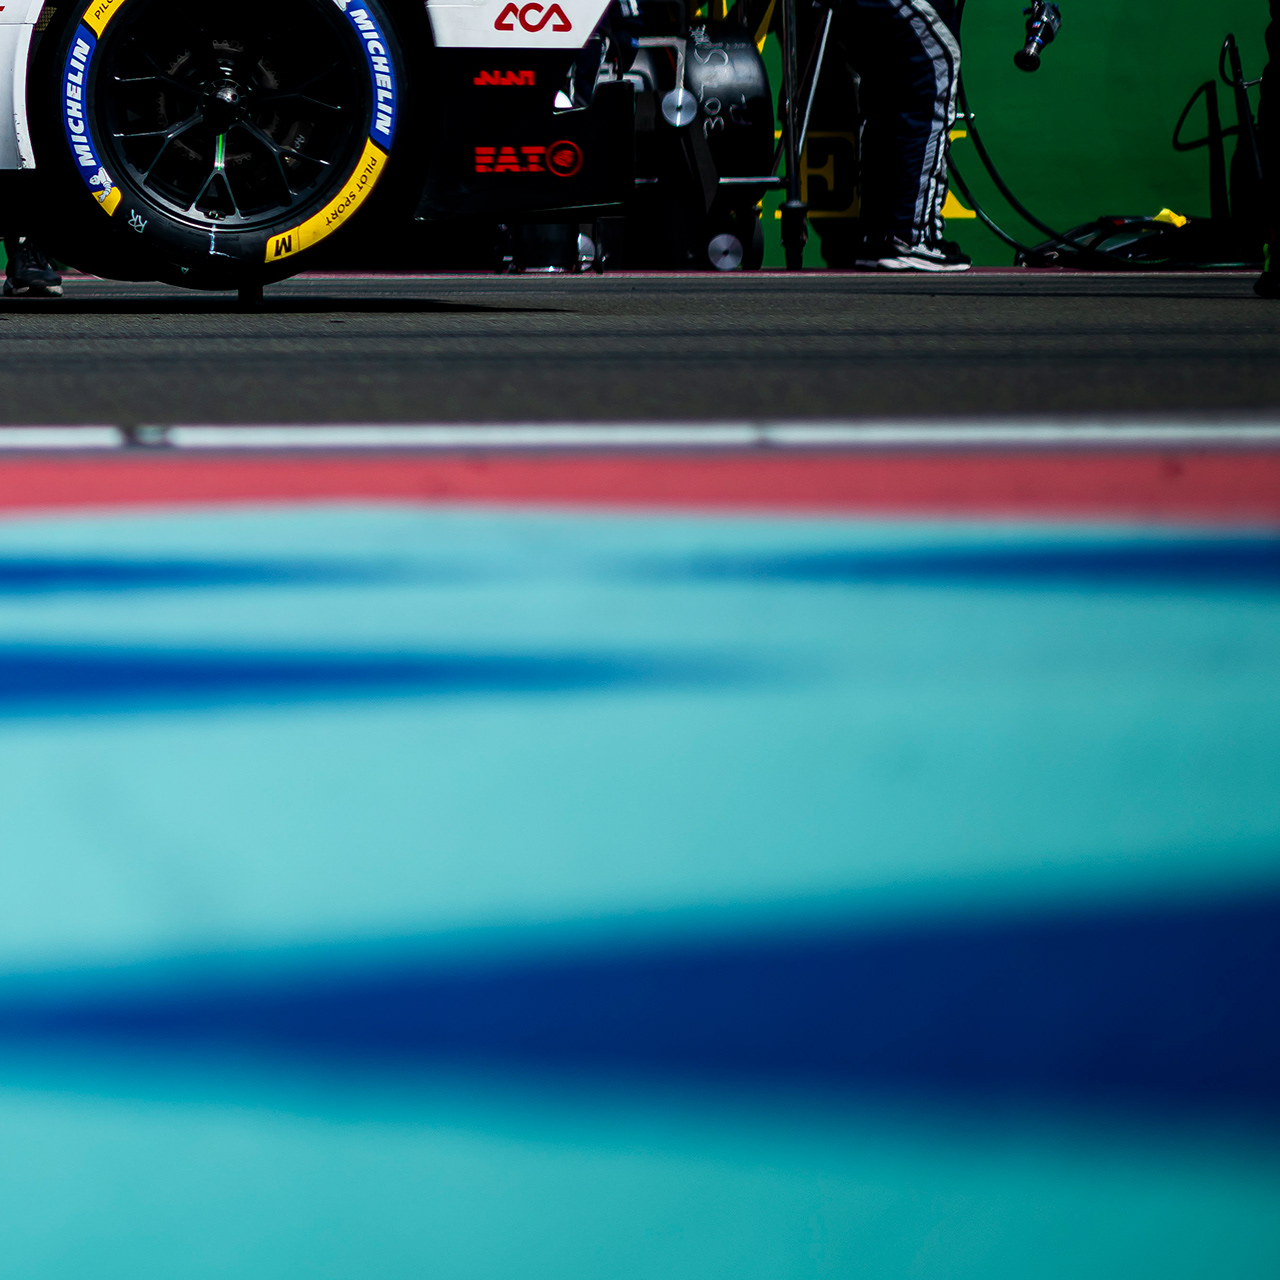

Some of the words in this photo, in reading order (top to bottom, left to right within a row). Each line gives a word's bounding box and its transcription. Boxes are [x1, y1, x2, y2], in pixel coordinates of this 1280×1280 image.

[67, 38, 97, 166] MICHELIN
[349, 9, 394, 134] MICHELIN
[325, 192, 359, 227] SPORT
[352, 156, 377, 192] PILOT
